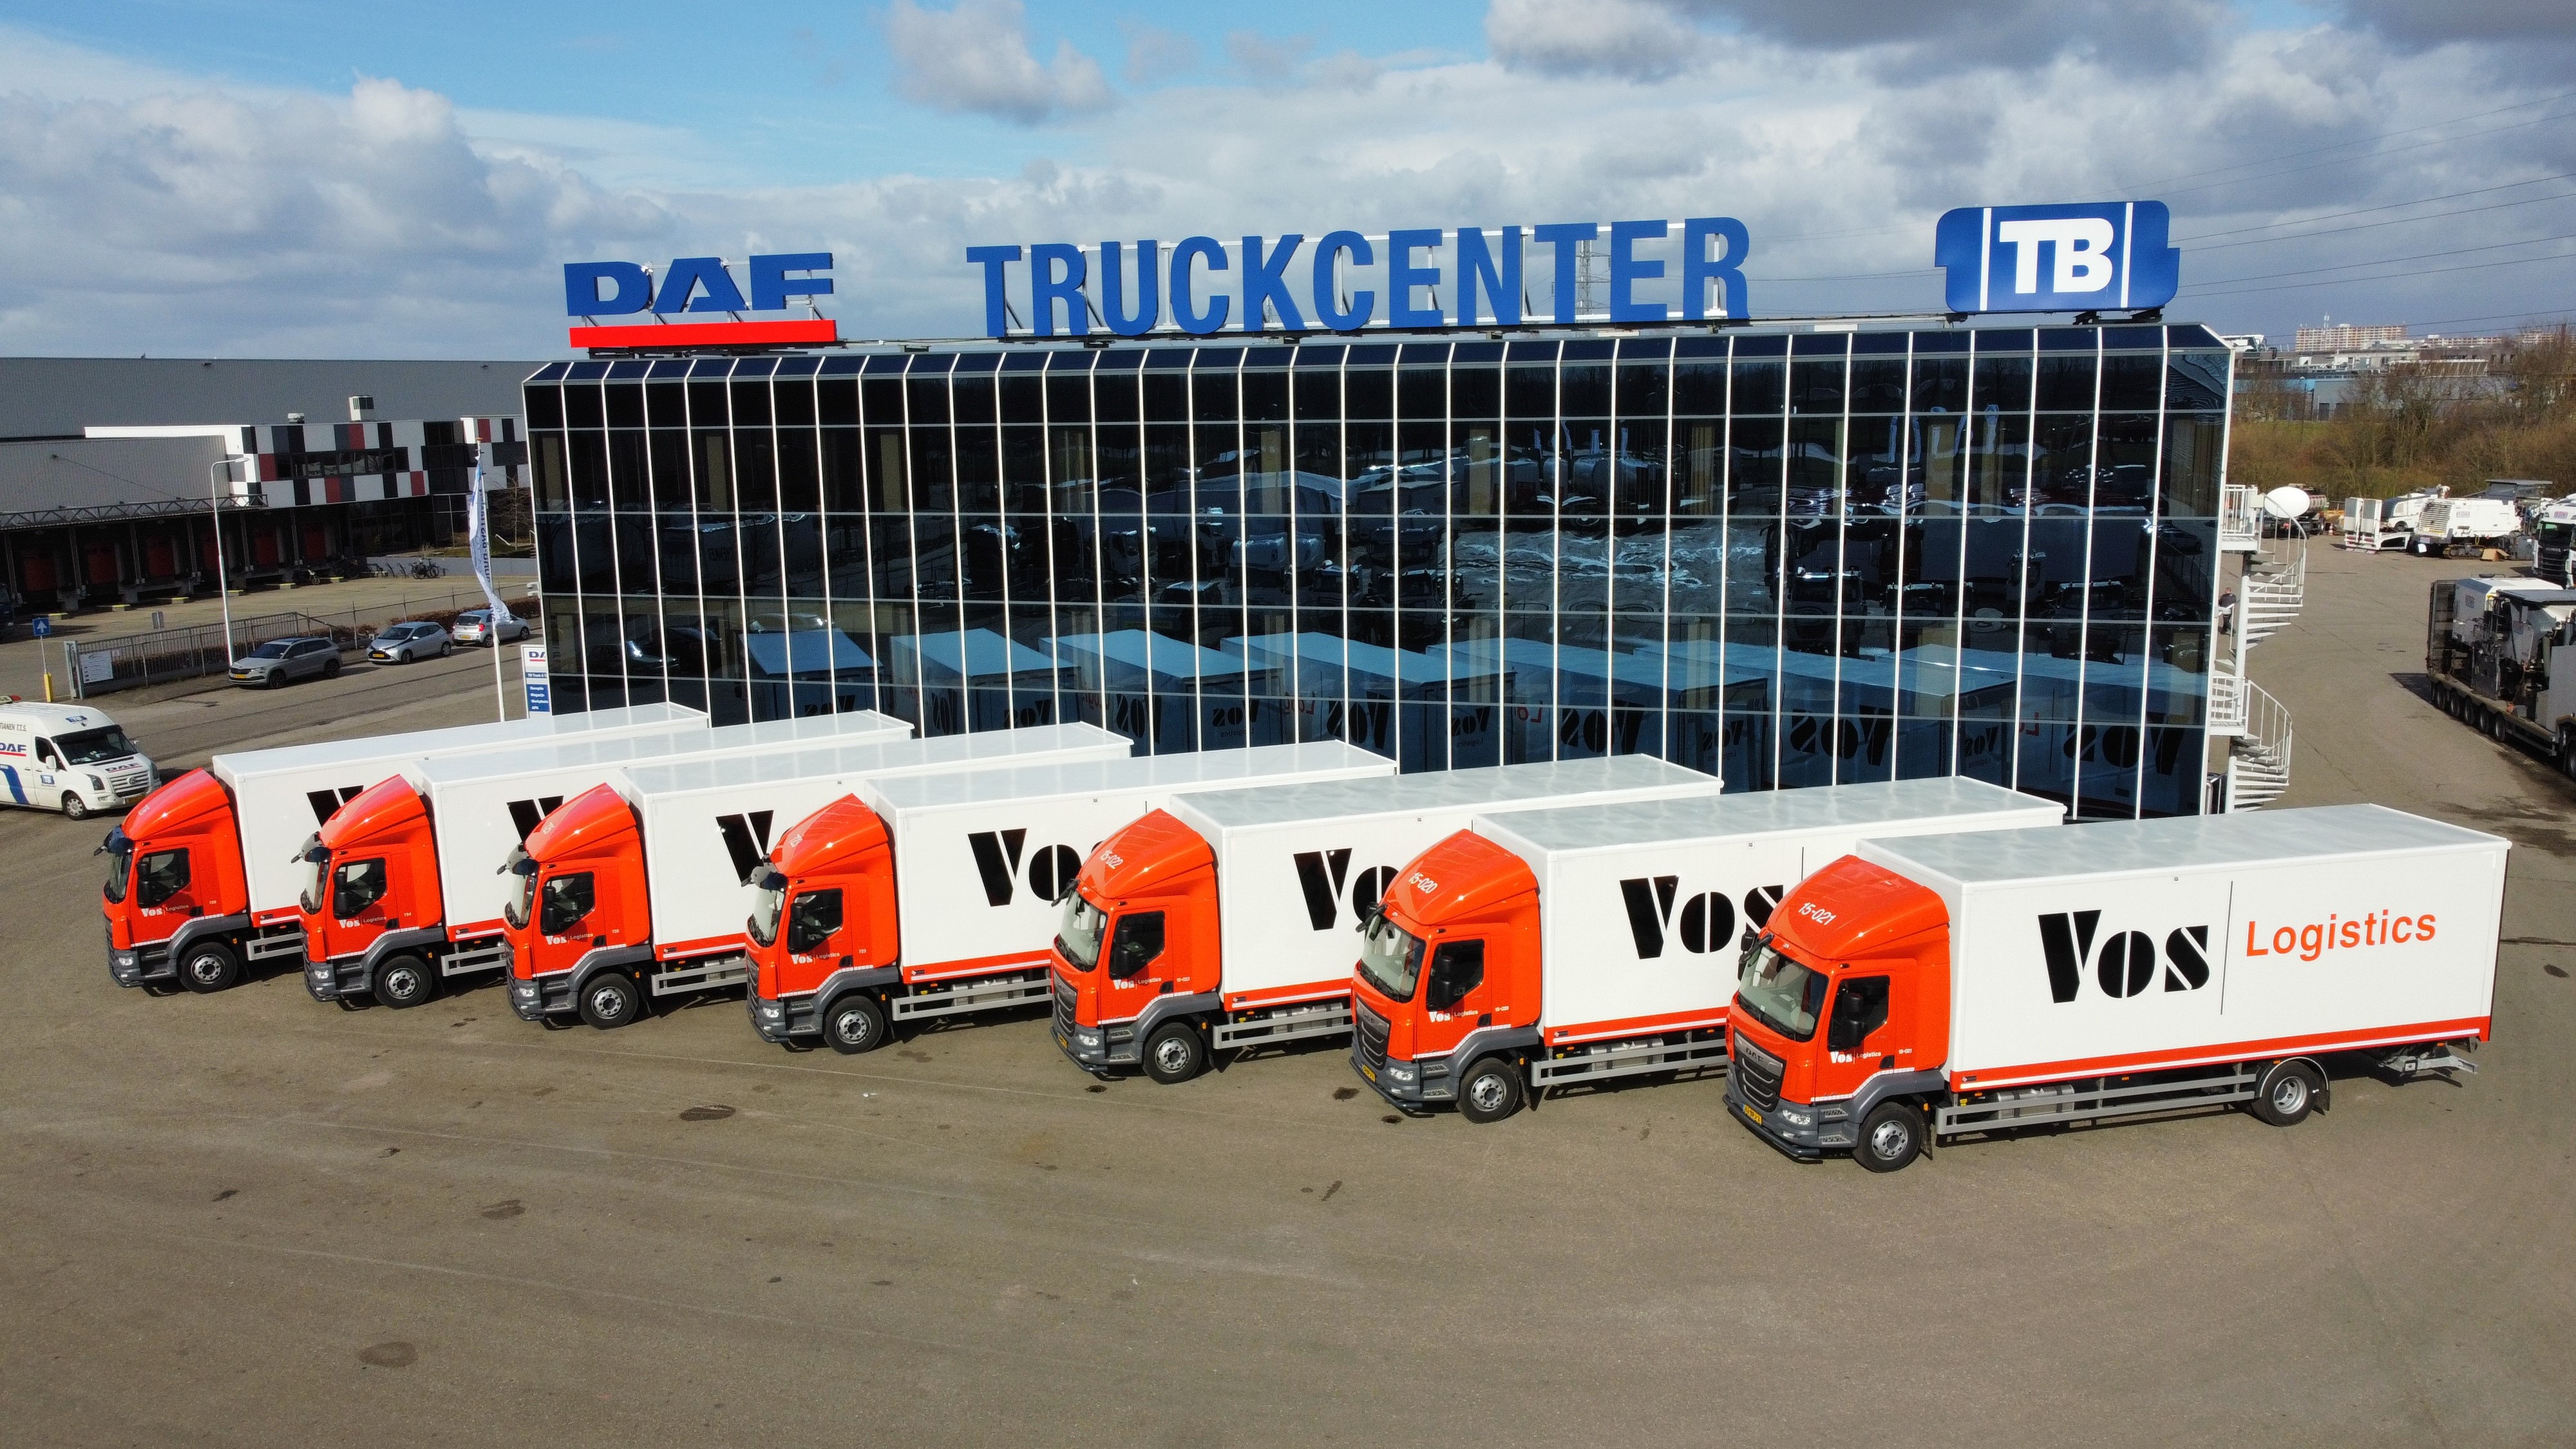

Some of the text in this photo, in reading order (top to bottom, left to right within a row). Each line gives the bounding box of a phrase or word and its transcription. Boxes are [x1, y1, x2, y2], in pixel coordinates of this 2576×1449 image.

[2000, 218, 2114, 294] TB
[564, 252, 834, 316] DAF
[967, 218, 1750, 338] TRUCKCENTER
[0, 743, 26, 752] DAF
[105, 762, 139, 772] DAF
[968, 828, 1103, 907] Vo
[1408, 871, 1438, 895] 15-020
[1798, 902, 1837, 926] 15-021
[2246, 909, 2437, 962] Logistics
[1746, 1047, 1764, 1063] DAF
